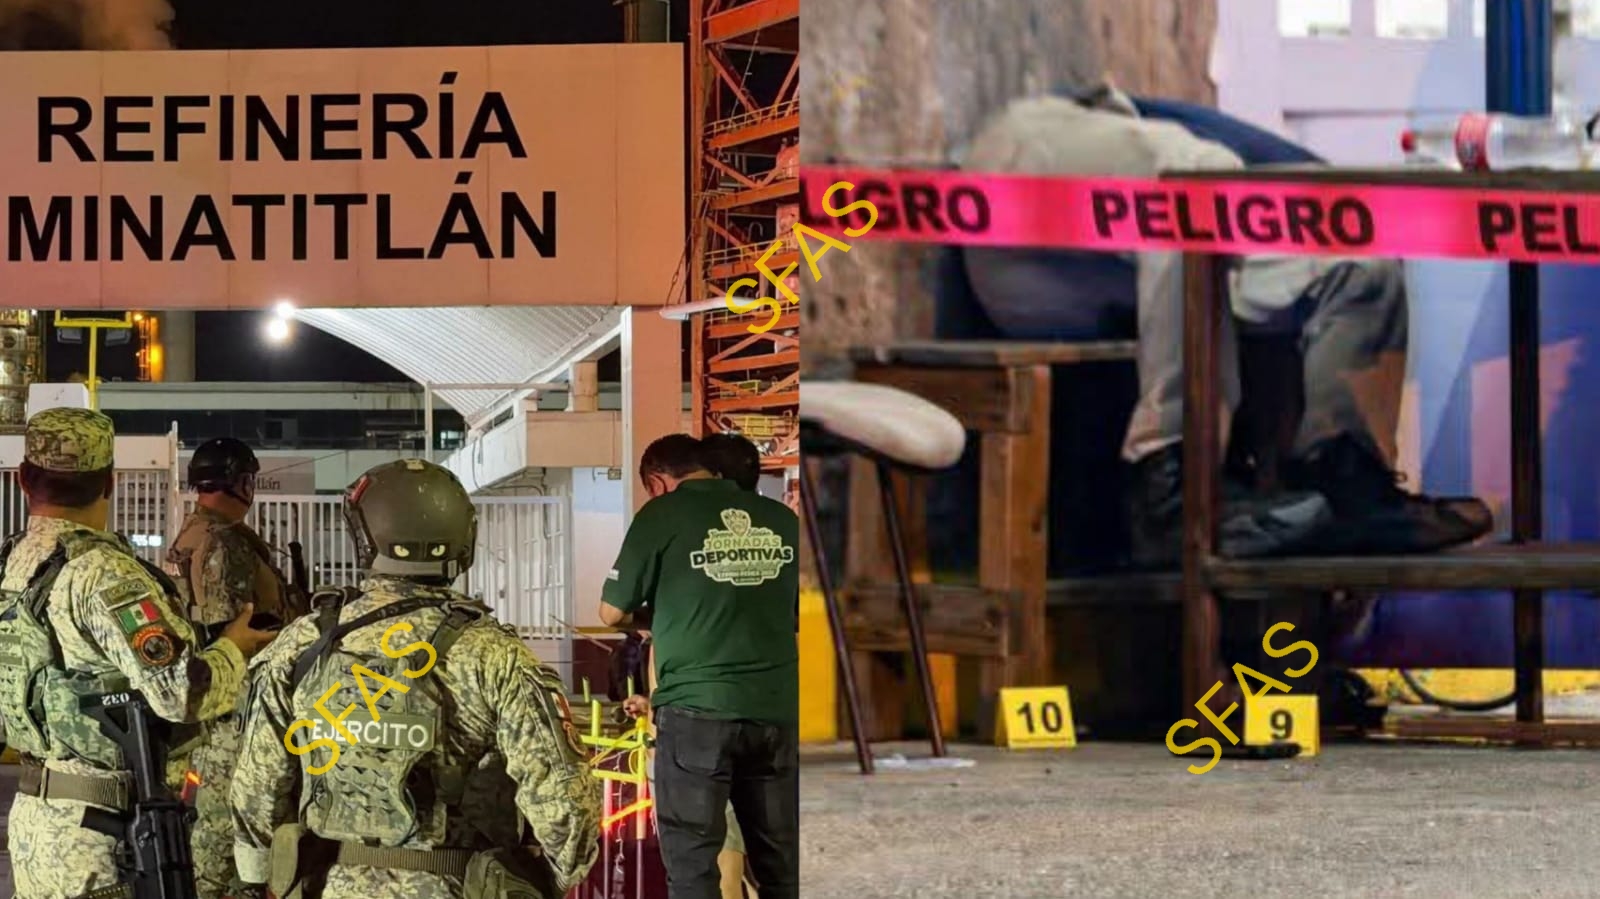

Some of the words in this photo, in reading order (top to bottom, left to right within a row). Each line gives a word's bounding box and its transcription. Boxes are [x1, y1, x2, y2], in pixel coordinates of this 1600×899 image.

[37, 71, 528, 163] REFINERÍA
[7, 172, 557, 261] MINATITLÁN
[1091, 190, 1374, 246] PELIGRO
[1478, 201, 1600, 254] PEL
[692, 548, 793, 566] DEPORTIVAS
[706, 537, 780, 550] JORNADAS
[311, 718, 428, 748] EJERCITO
[1016, 701, 1063, 734] 10
[1269, 708, 1294, 741] 9
